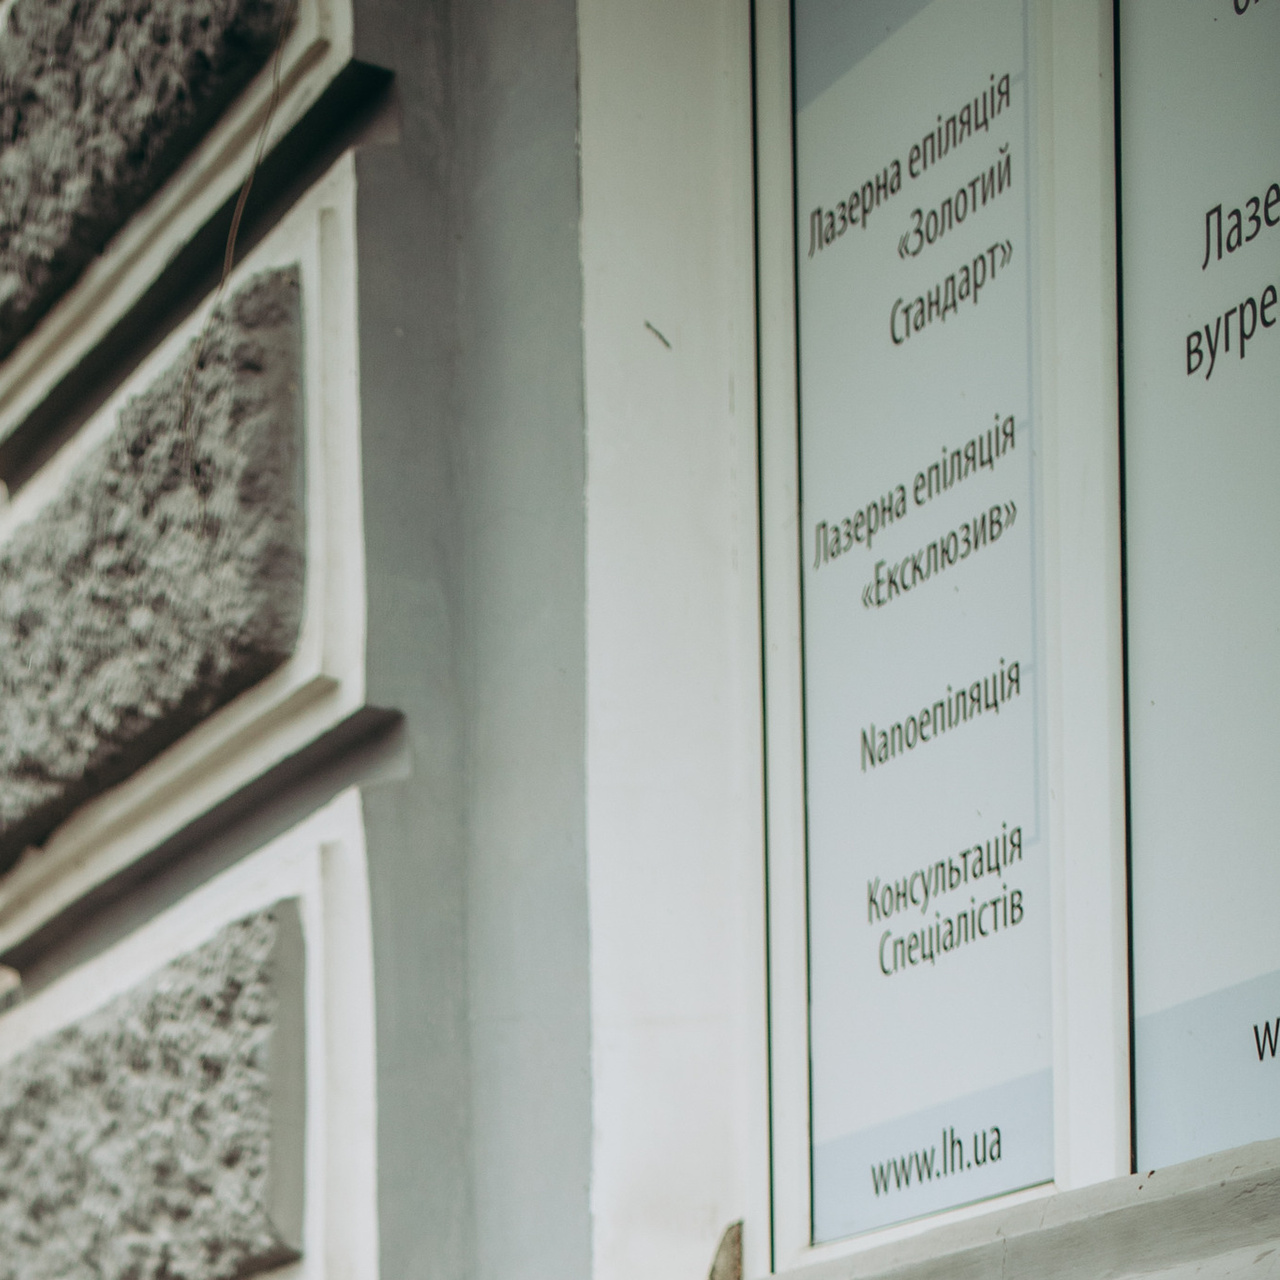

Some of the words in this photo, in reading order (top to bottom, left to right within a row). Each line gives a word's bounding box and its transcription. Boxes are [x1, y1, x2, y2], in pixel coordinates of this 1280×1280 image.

[808, 158, 902, 259] Лазерна
[908, 73, 1010, 179] епіляція
[897, 141, 1012, 260] «Золотий
[1202, 182, 1280, 271] Лазе
[889, 239, 1013, 346] Стандарт»
[1186, 284, 1279, 381] вугре
[813, 483, 907, 570] Лазерна
[913, 412, 1016, 506] епіляція
[861, 499, 1018, 608] «Ексклюзив»
[867, 820, 1023, 926] Консультація
[878, 882, 1024, 977] Спеціалістів
[871, 1125, 1002, 1198] www.lh.ua
